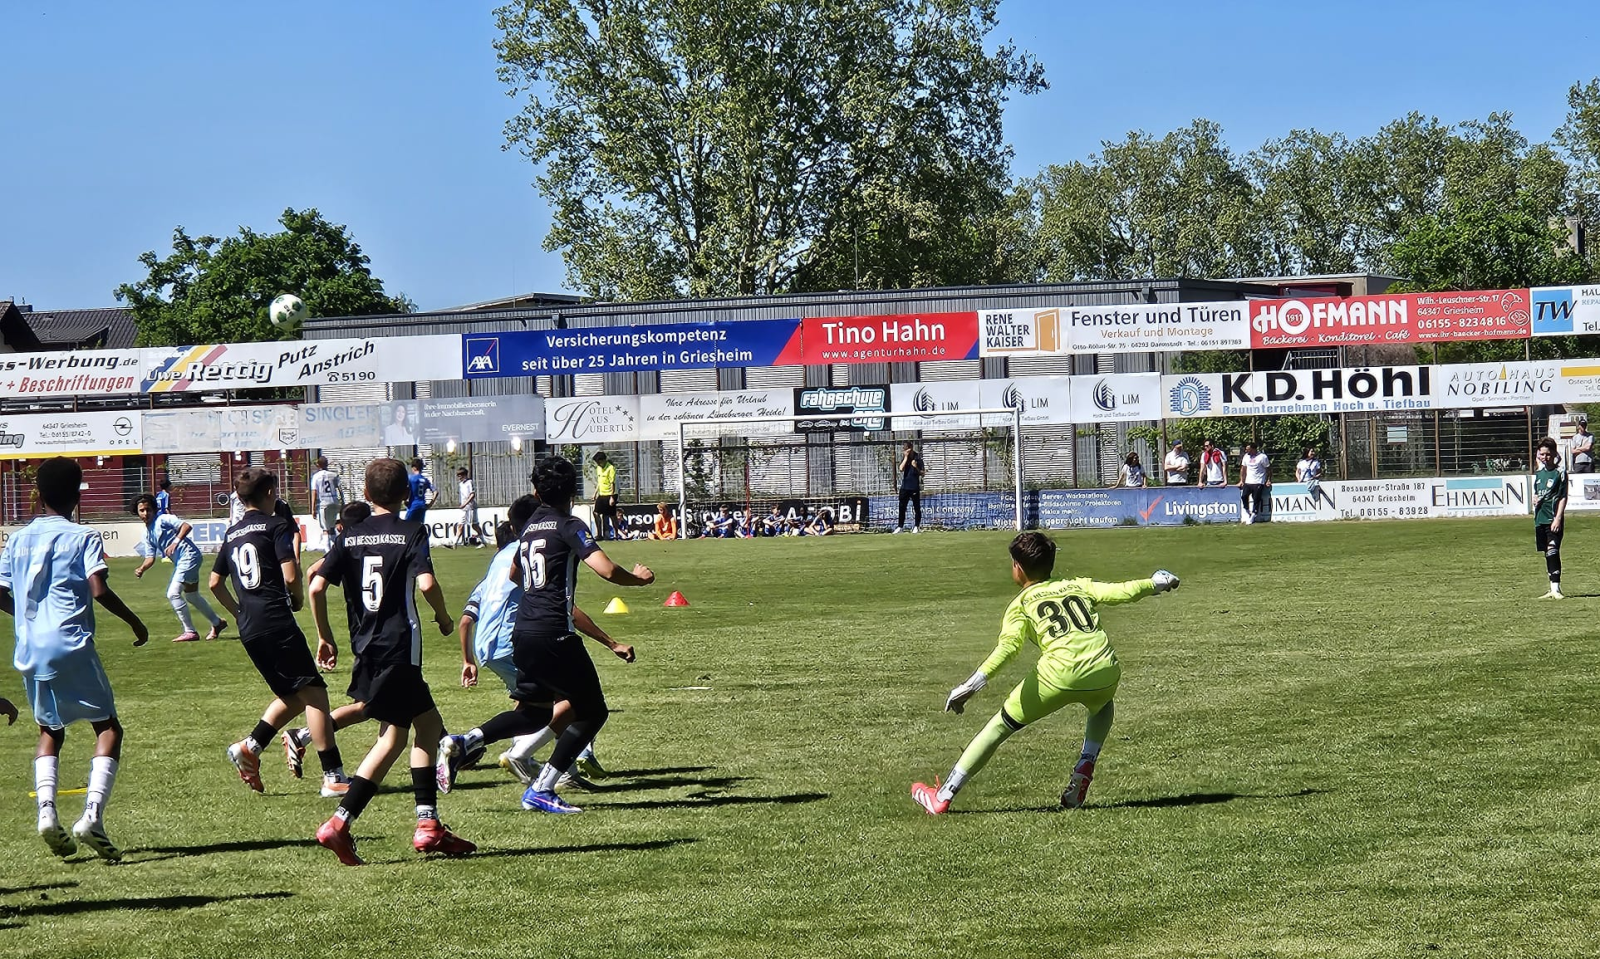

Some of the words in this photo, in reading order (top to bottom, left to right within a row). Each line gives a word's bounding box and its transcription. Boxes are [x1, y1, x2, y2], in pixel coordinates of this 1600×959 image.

[1071, 310, 1139, 327] Fenster
[1145, 306, 1181, 324] und
[1187, 305, 1241, 322] Türen
[1252, 299, 1408, 335] HOFMANN
[1286, 313, 1303, 323] 1911
[1417, 307, 1441, 316] 64347
[1443, 305, 1484, 315] Griesheim
[1534, 299, 1578, 322] TW
[985, 313, 1013, 325] RENE
[822, 321, 876, 345] Tino
[882, 318, 945, 342] Hahn
[985, 324, 1030, 336] WALTER
[1101, 327, 1141, 338] Verkauf
[1144, 327, 1164, 337] und
[1167, 326, 1213, 338] Montage
[1318, 331, 1376, 343] Konditorei
[1385, 329, 1410, 341] Café
[1418, 328, 1527, 339] www.ihr-baecker-hofmann.de
[546, 329, 727, 348] Versicherungskompetenz
[986, 336, 1024, 348] KAISER
[278, 344, 318, 369] Putz
[522, 356, 548, 371] seit
[552, 355, 585, 369] über
[588, 355, 605, 367] 25
[609, 353, 658, 367] Jahren
[662, 350, 676, 364] in
[680, 348, 752, 363] Griesheim
[822, 345, 946, 359] www.agenturhahn.de
[298, 341, 375, 380] Anstrich
[467, 355, 494, 370] AXA
[146, 369, 181, 381] Uwe
[185, 359, 273, 383] Rettig
[18, 374, 134, 392] Beschriftungen
[1222, 372, 1305, 403] K.D.
[1312, 367, 1430, 400] Höhl
[1447, 379, 1552, 396] NOBILING
[685, 397, 718, 407] Adresse
[719, 397, 733, 407] für
[736, 394, 768, 404] Urlaub
[1031, 398, 1049, 408] LIM
[1122, 394, 1140, 404] LIM
[658, 413, 671, 421] der
[673, 411, 704, 421] schönen
[707, 409, 753, 419] Lüneburger
[756, 406, 787, 417] Heide!
[1222, 403, 1327, 415] Bauunternehmen
[1333, 400, 1364, 411] Hoch
[1368, 401, 1379, 410] u.
[1383, 399, 1431, 409] Tiefbau
[502, 422, 540, 432] EVERNEST
[324, 480, 331, 493] 2
[1414, 482, 1425, 490] 187
[1352, 495, 1375, 503] 64347
[1377, 494, 1416, 502] Griesheim
[1431, 482, 1524, 507] EHMANN
[1165, 500, 1237, 518] Livingston
[1340, 509, 1356, 518] Tel.
[1360, 507, 1389, 517] 06155
[1089, 515, 1118, 523] kaufen
[380, 534, 406, 545] KASSEL
[231, 542, 261, 590] 19
[520, 538, 547, 592] 55
[362, 555, 384, 612] 5
[1037, 594, 1097, 639] 30
